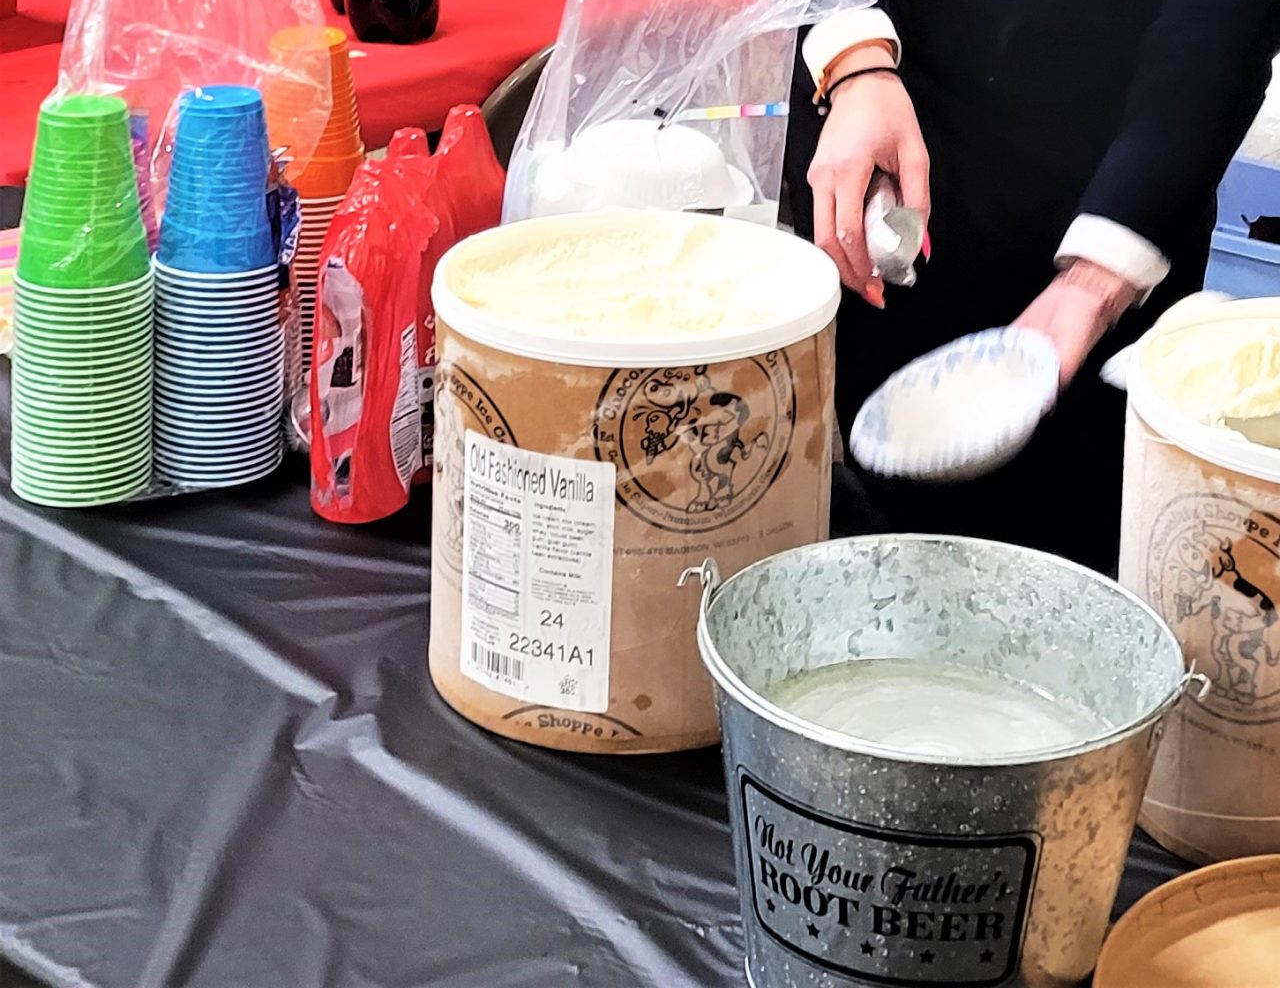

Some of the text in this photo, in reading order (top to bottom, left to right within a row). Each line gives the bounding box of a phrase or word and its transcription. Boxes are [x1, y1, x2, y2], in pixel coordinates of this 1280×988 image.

[470, 444, 486, 477] Old
[488, 451, 547, 495] Fashioned
[550, 468, 594, 503] Vanilla
[540, 609, 565, 629] 24
[509, 633, 594, 666] 22341A1
[538, 714, 603, 737] Shoppe
[755, 814, 1013, 905] Not Your Father's
[759, 857, 1005, 942] ROOT BEER
